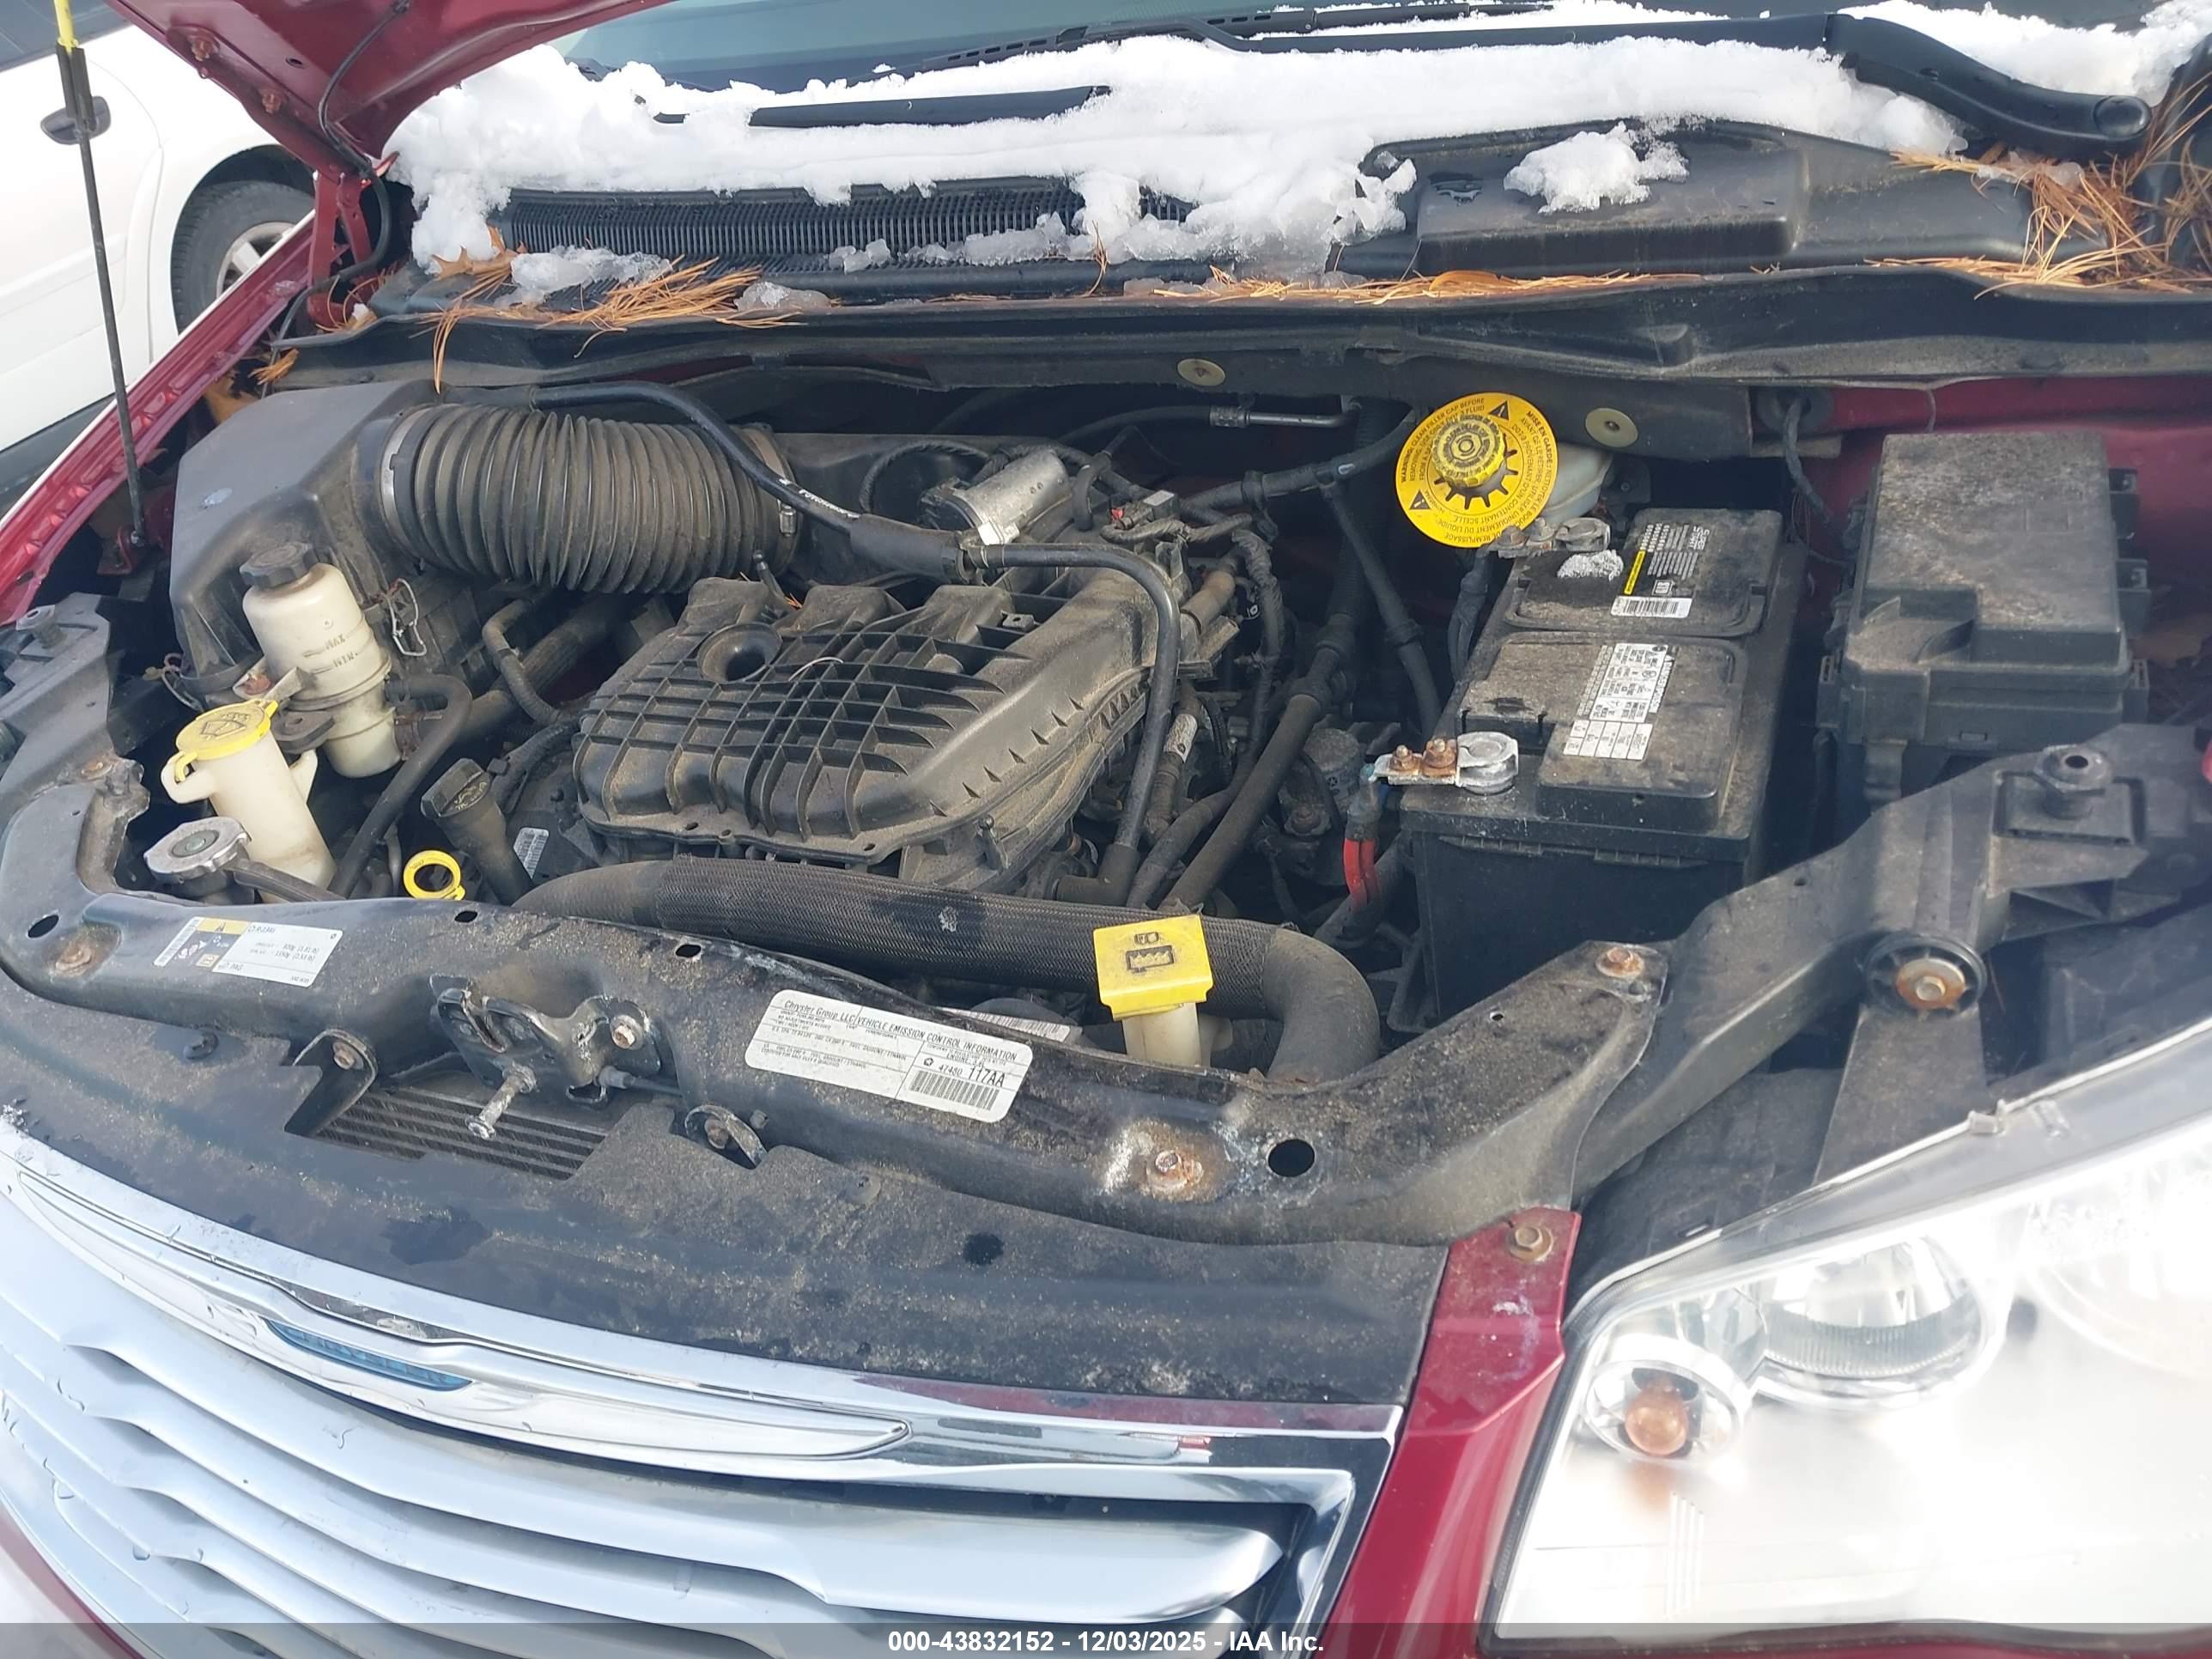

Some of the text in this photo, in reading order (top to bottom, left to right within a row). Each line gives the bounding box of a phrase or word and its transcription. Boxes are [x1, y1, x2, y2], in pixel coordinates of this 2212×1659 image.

[1410, 426, 1427, 447] CLEAN
[1424, 411, 1445, 429] FILLER
[1444, 403, 1460, 415] CAP
[1458, 398, 1484, 408] BEFORE
[1465, 404, 1485, 414] FLUID
[1524, 409, 1542, 427] MISE
[1537, 424, 1547, 437] EN
[1480, 497, 1519, 524] CONTENANT
[784, 1000, 815, 1013] Chrysler
[817, 1007, 839, 1021] Group
[841, 1012, 856, 1023] LLC
[858, 1016, 888, 1030] VEHICLE
[888, 1023, 925, 1039] EMISSION
[927, 1033, 961, 1047] CONTROL
[963, 1041, 1018, 1061] INFORMATION
[968, 1065, 1006, 1088] 117AA
